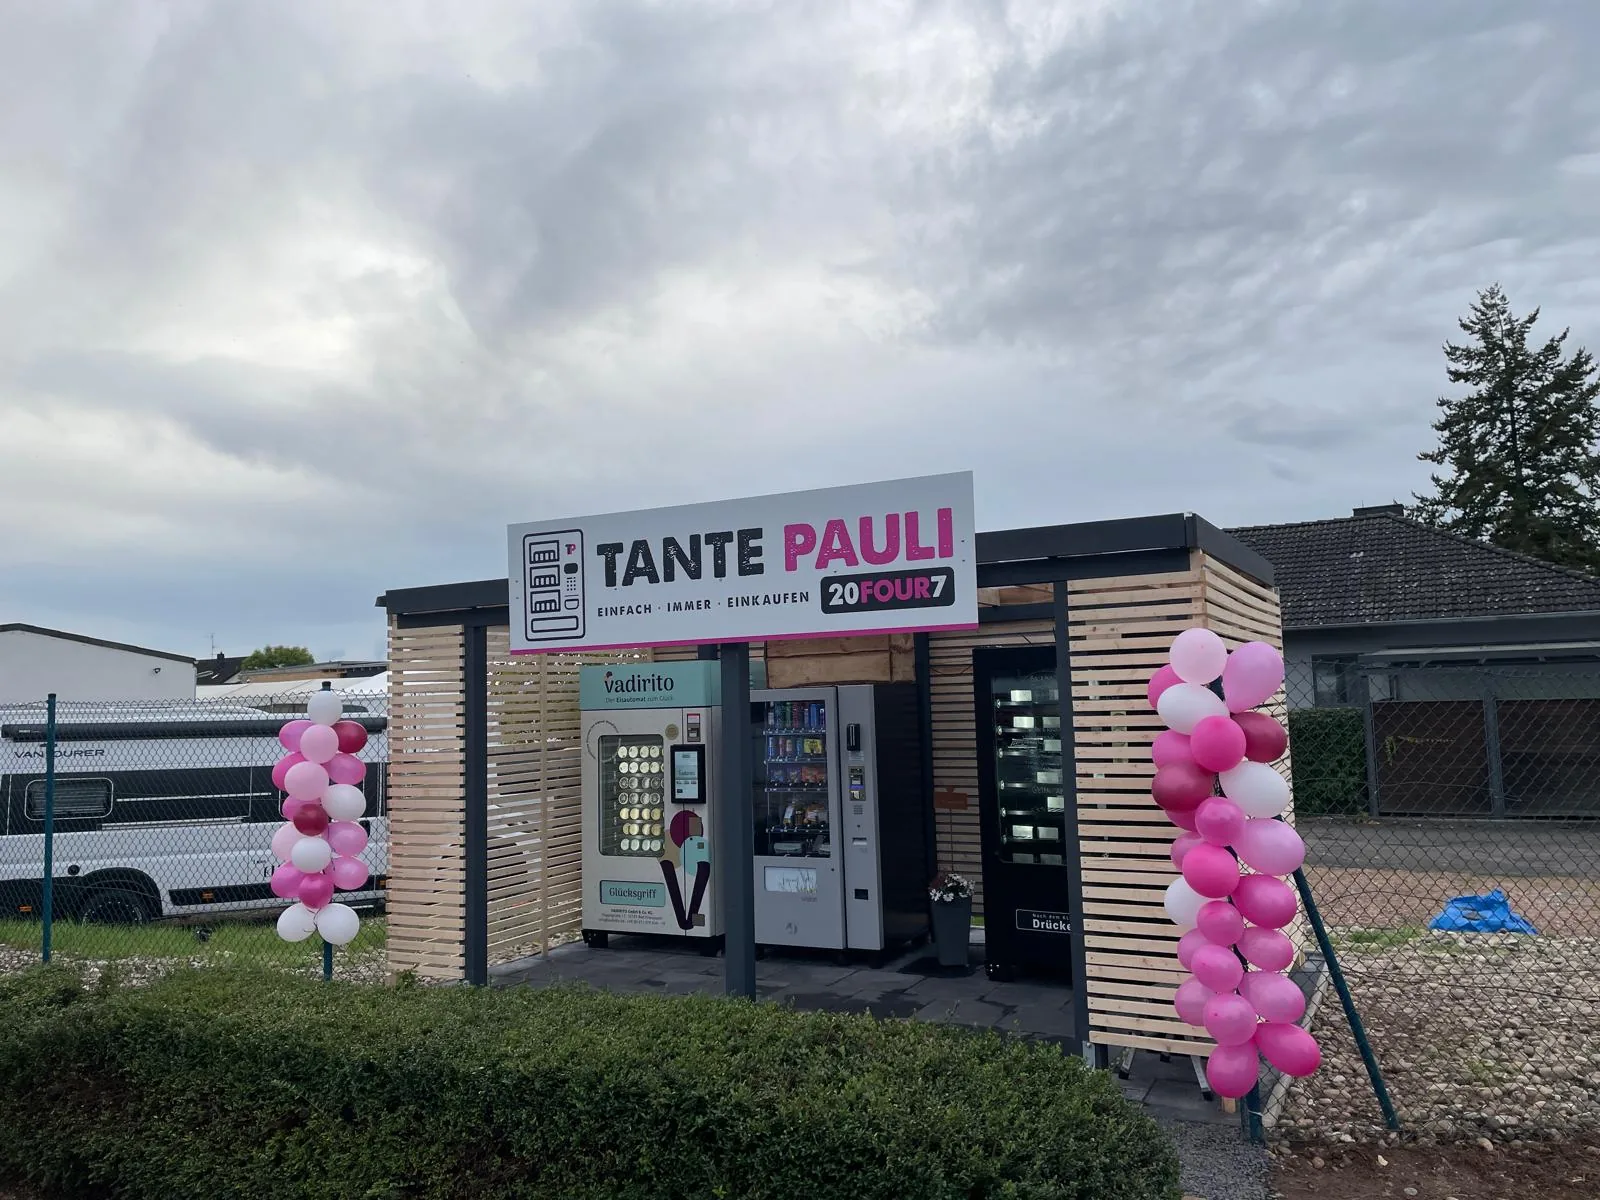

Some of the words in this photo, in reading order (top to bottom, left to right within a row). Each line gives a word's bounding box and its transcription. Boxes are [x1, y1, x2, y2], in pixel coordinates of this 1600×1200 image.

[597, 528, 764, 587] TANTE
[784, 508, 954, 571] PAULI
[828, 575, 948, 606] 20FOUR7
[597, 604, 652, 617] EINFACH
[667, 599, 712, 612] IMMER
[727, 591, 810, 608] EINKAUFEN
[604, 674, 674, 693] vadirito
[14, 749, 105, 758] VANOURER
[609, 887, 657, 901] Glücksgriff
